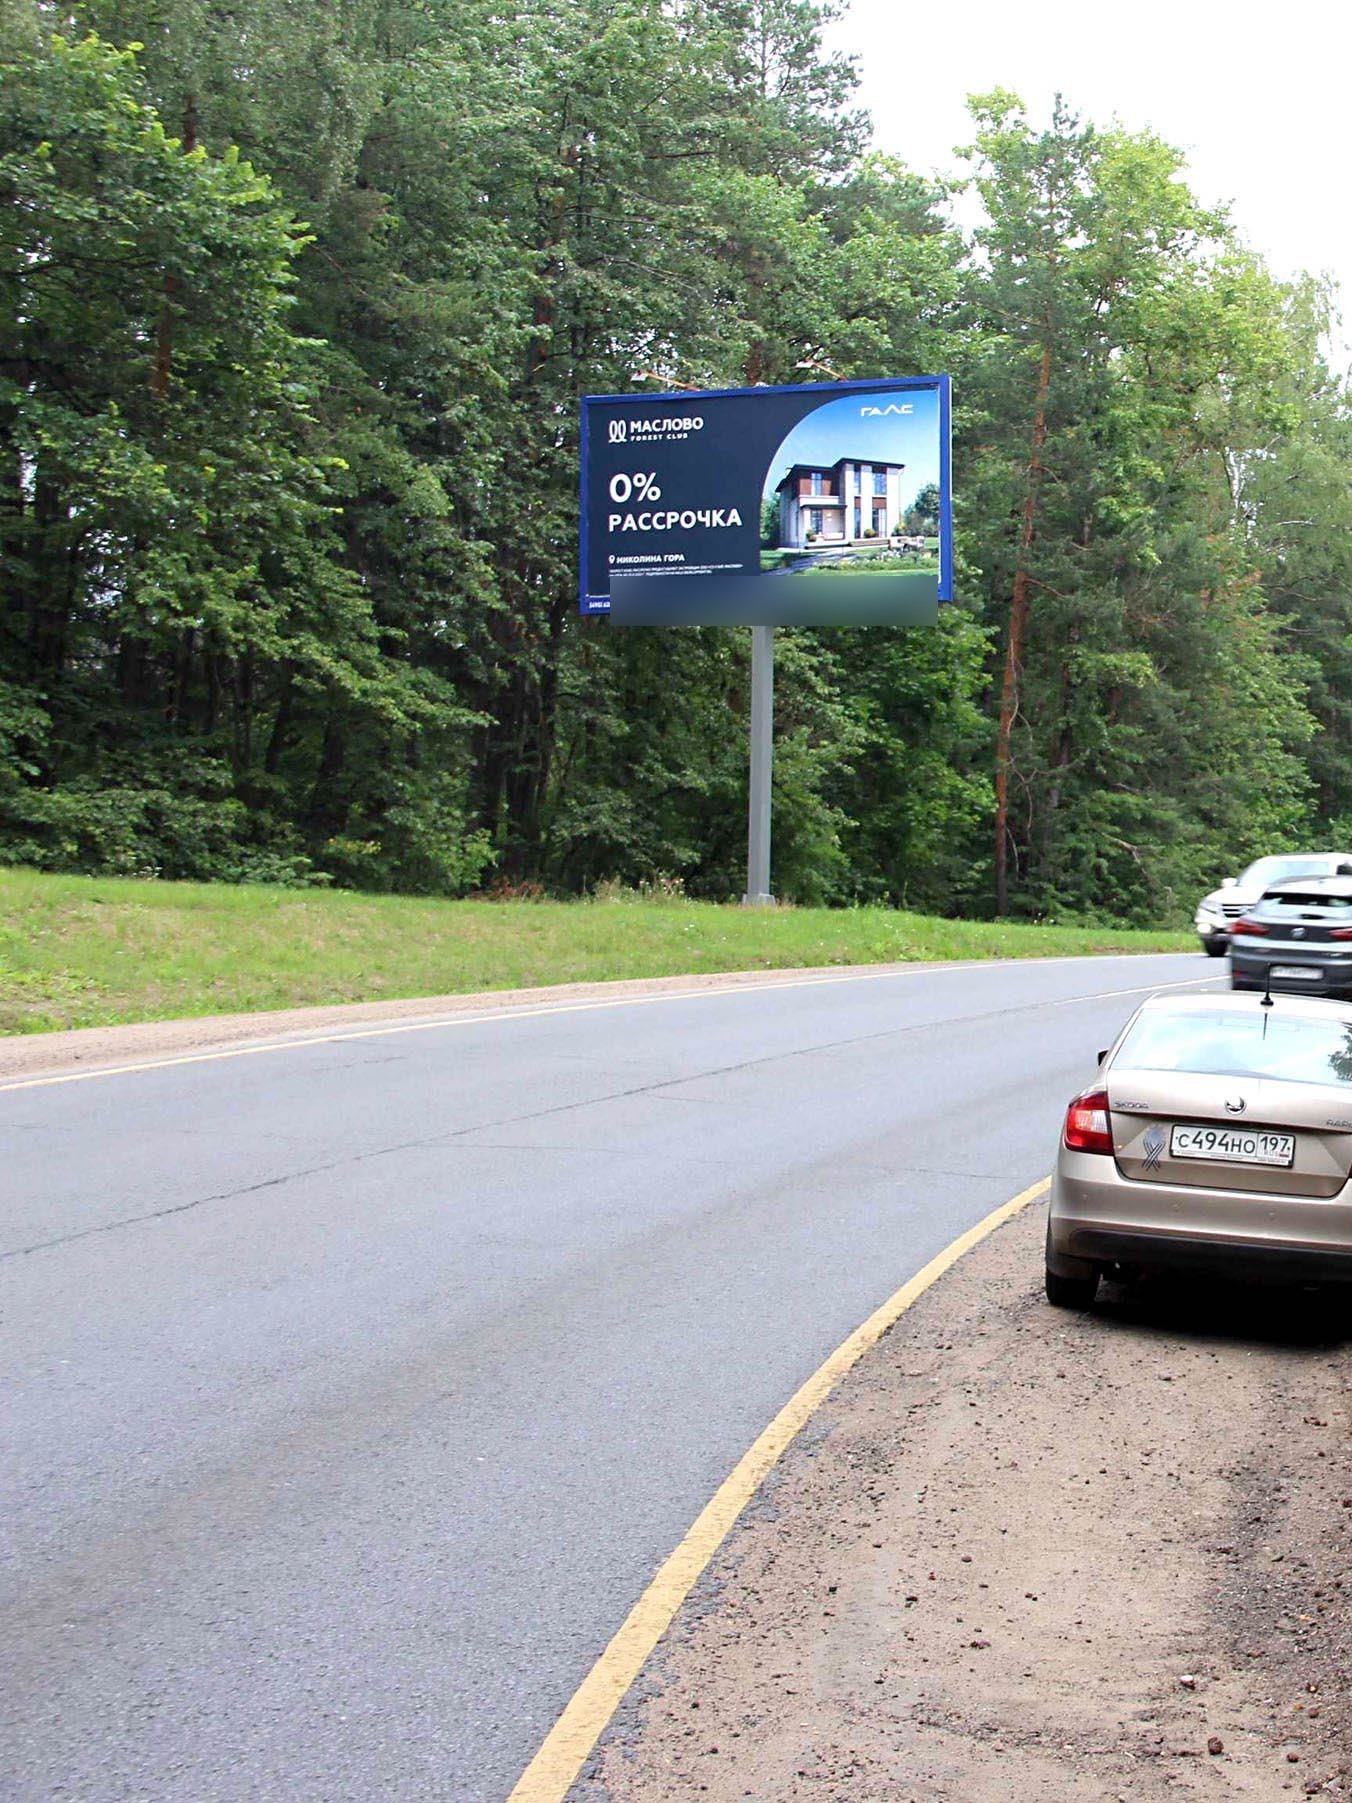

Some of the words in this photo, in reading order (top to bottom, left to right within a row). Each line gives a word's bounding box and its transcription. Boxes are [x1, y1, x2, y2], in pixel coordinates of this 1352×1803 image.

[630, 417, 704, 433] МАСЛОВО
[630, 434, 663, 442] FOREST
[609, 472, 661, 503] 0%
[608, 508, 742, 532] РАССРОЧКА
[616, 555, 662, 564] НИКОЛИНА
[663, 554, 685, 562] ГОРА
